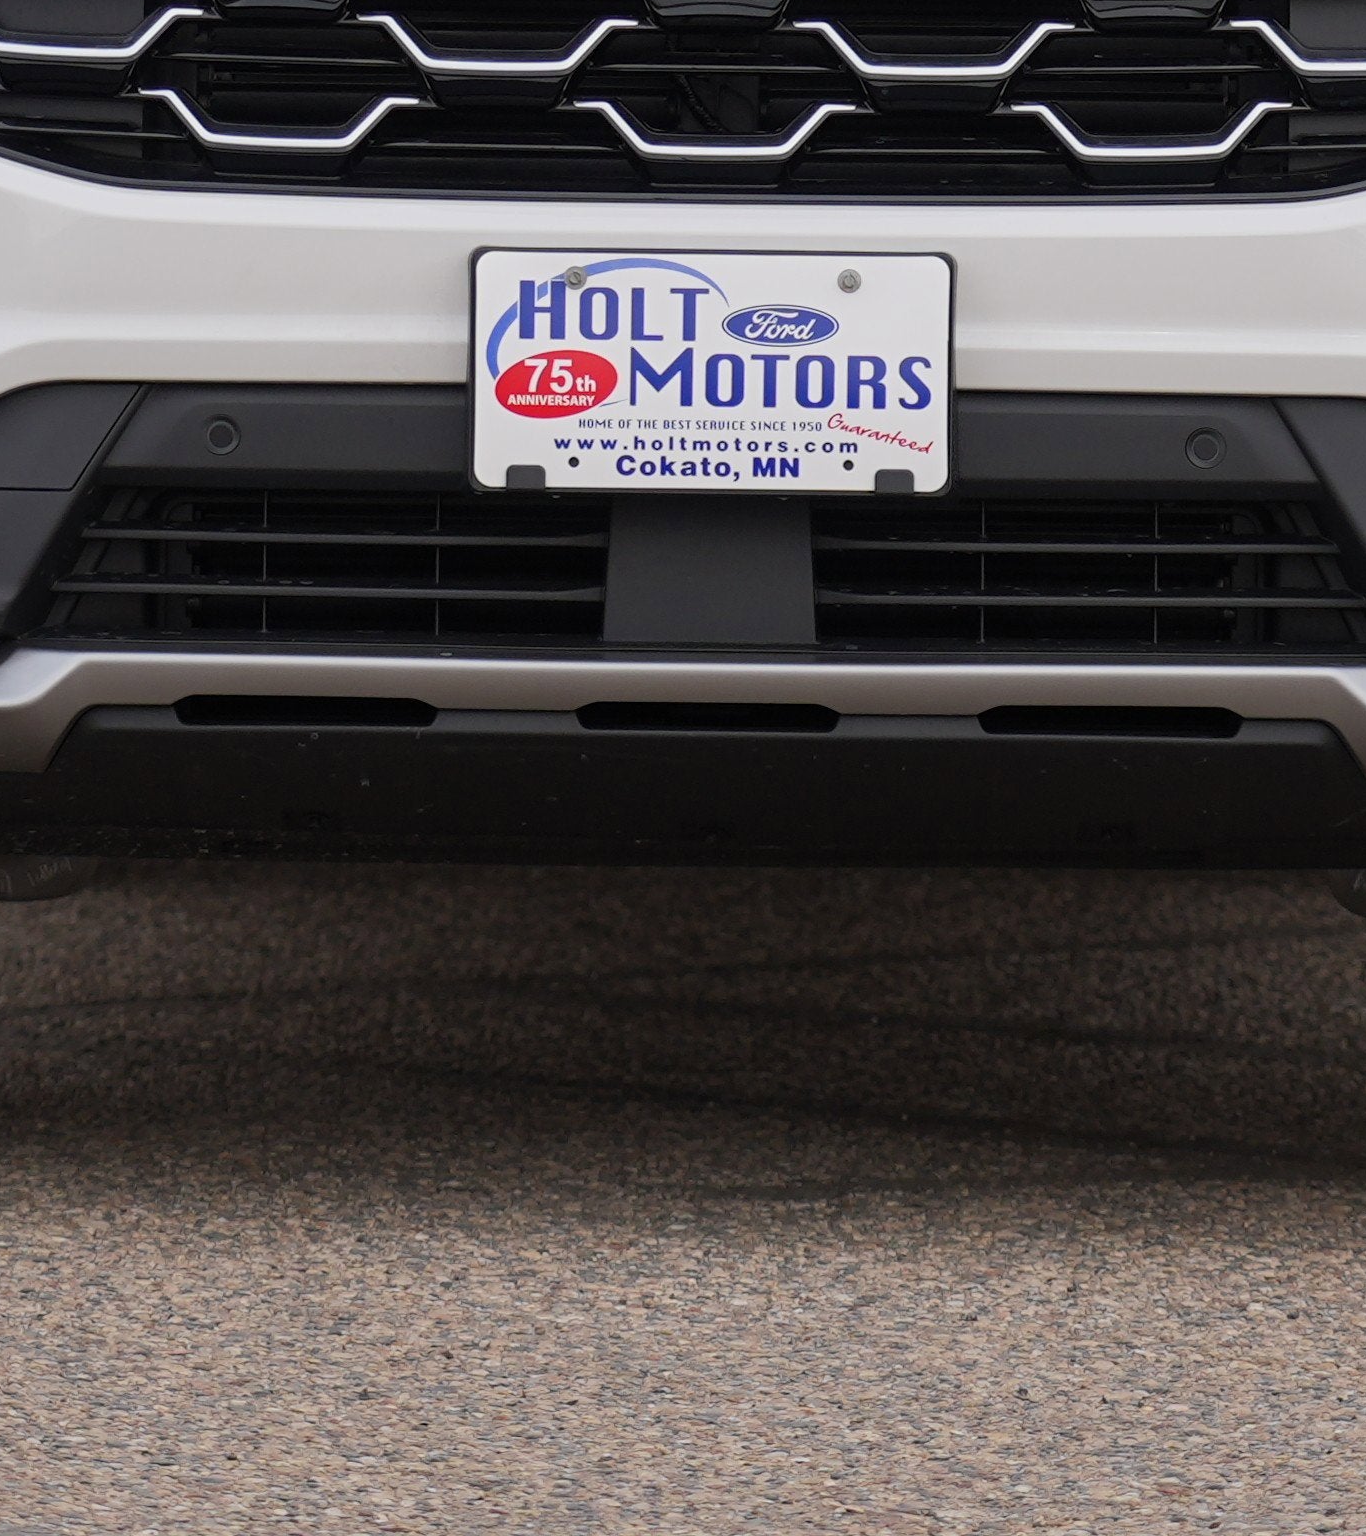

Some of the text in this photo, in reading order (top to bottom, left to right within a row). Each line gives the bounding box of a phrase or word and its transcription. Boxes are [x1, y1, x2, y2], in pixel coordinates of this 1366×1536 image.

[518, 279, 710, 342] HOLT
[744, 309, 816, 340] Ford
[524, 358, 597, 394] 75th
[629, 346, 933, 410] MOTORS
[506, 394, 596, 407] ANNIVERSARY
[554, 435, 859, 454] www.holtmotors.com
[578, 412, 935, 455] HOME OF THE BEST SERVICE SINCE 1950 Guaranteed
[616, 454, 800, 483] Cokato, MN
